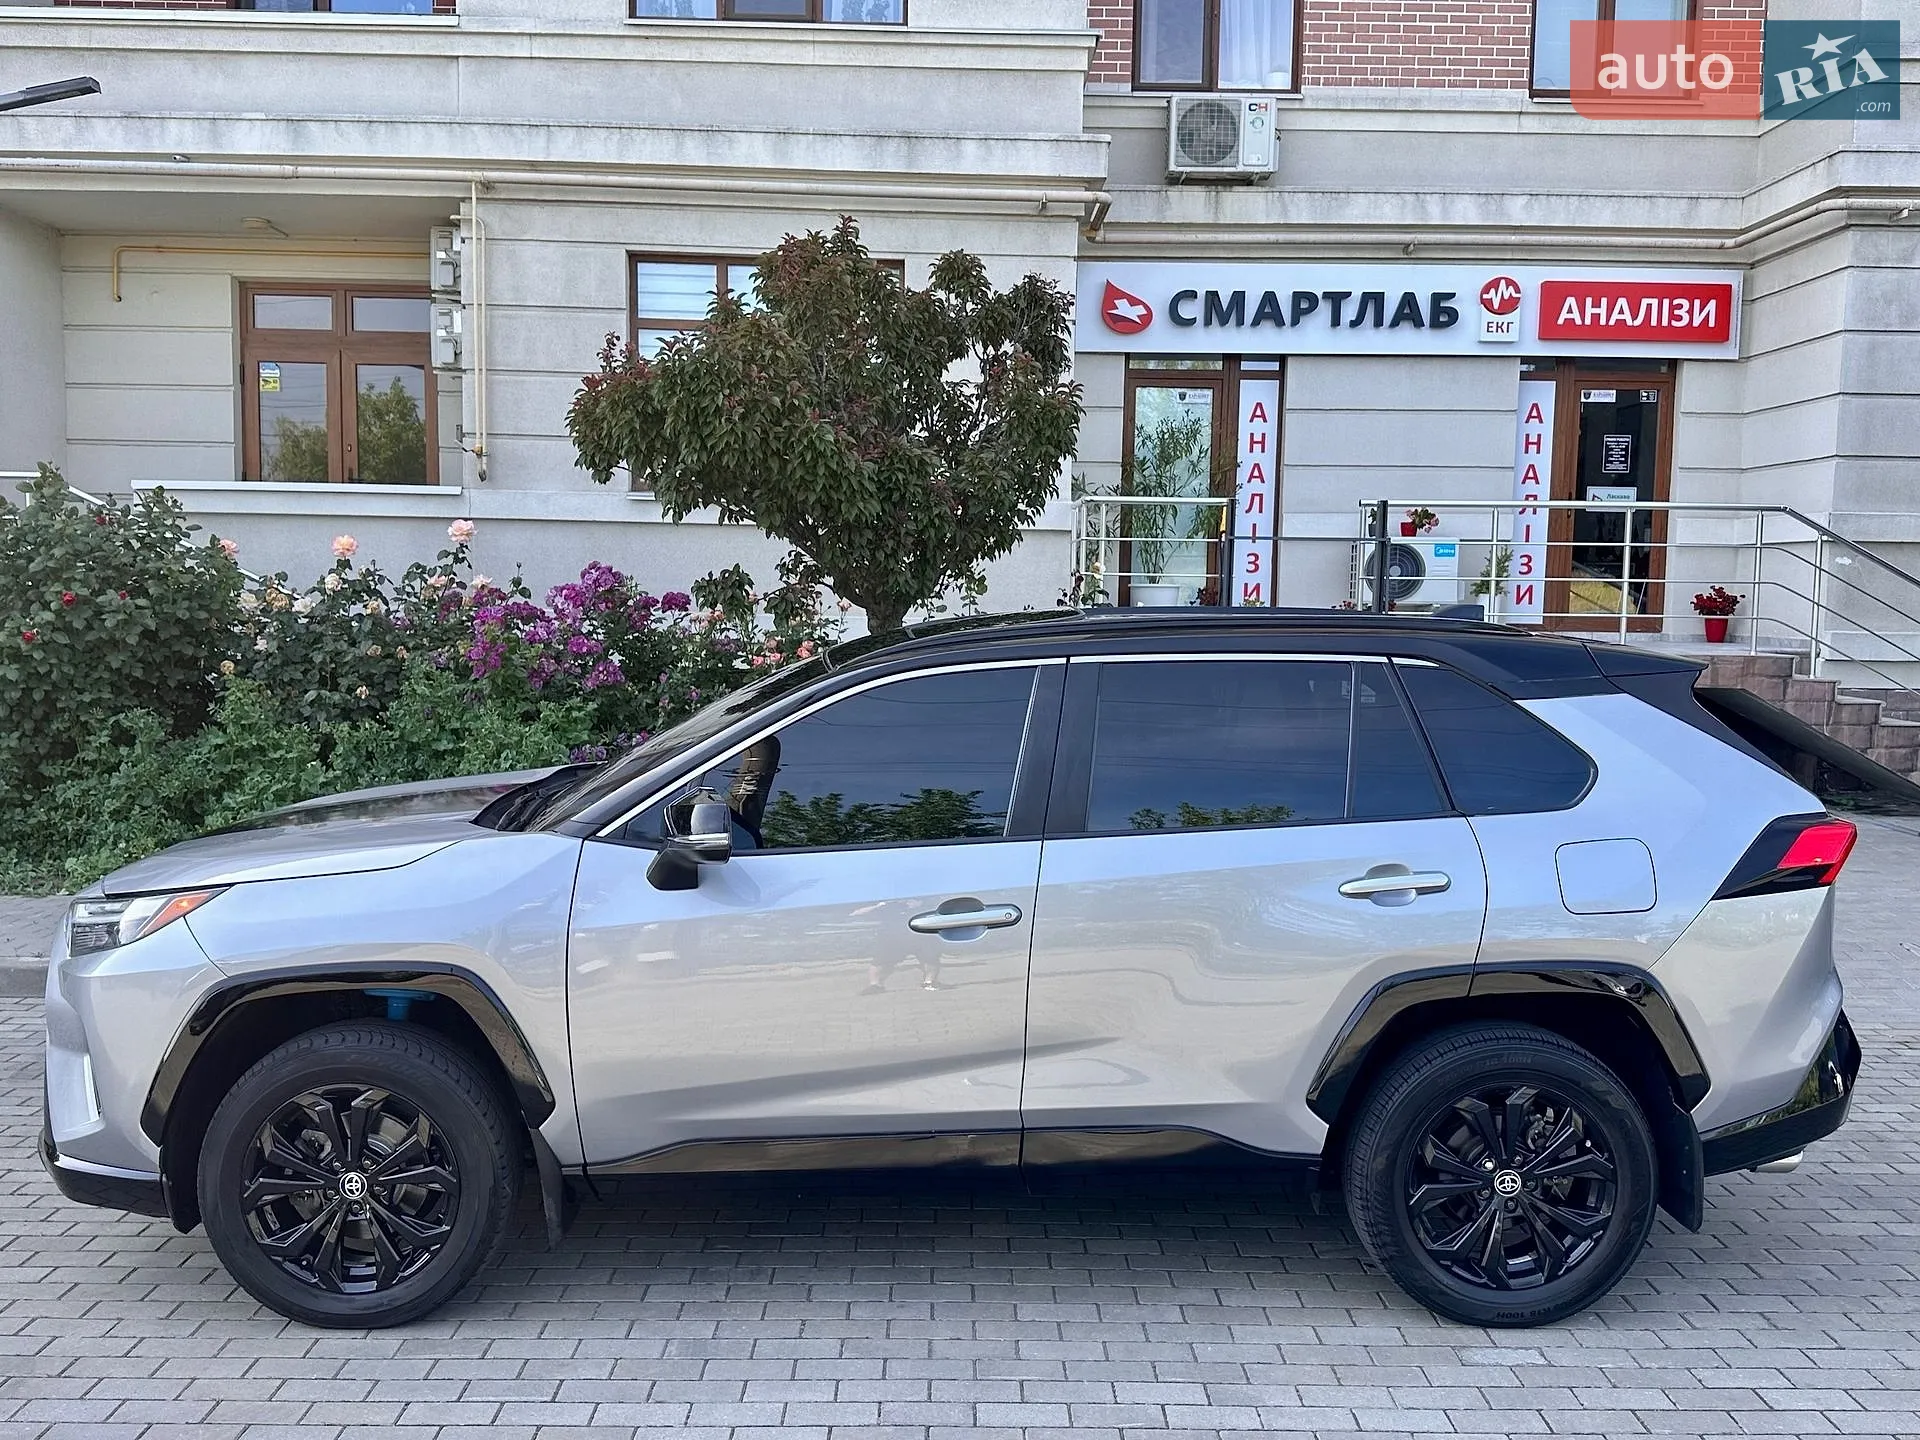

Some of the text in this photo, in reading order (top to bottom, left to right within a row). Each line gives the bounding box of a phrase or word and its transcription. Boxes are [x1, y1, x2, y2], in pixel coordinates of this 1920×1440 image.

[1248, 103, 1268, 112] CH
[1168, 289, 1460, 329] СМАРТЛАБ
[1556, 296, 1717, 328] АНАЛІЗИ
[1486, 321, 1514, 334] ЕКГ
[1242, 402, 1268, 603] АНАЛІЗИ
[1515, 402, 1544, 605] АНАЛІЗИ
